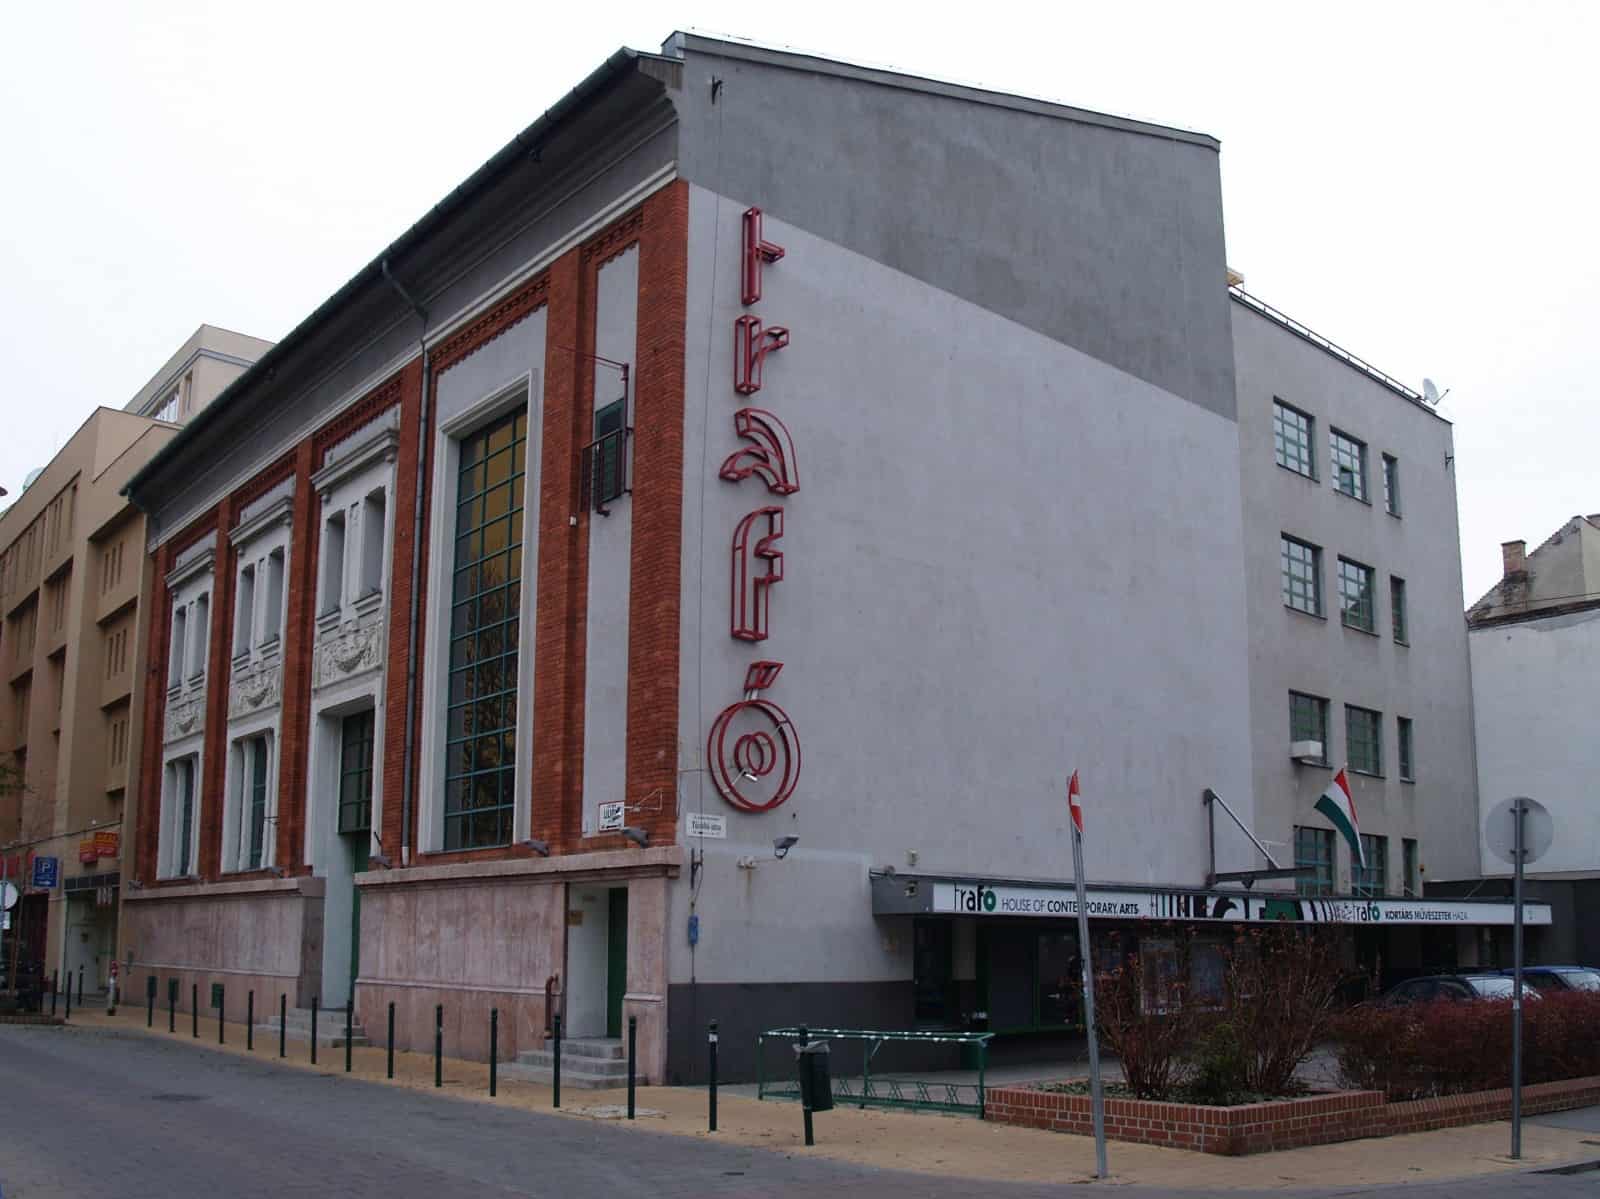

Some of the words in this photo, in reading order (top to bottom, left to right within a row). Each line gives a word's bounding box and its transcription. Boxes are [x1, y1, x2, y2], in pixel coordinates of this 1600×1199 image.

[1001, 898, 1032, 912] HOUSE
[1033, 899, 1045, 912] OF
[1047, 899, 1118, 914] CONTEPORARY
[1119, 903, 1139, 915] ARTS
